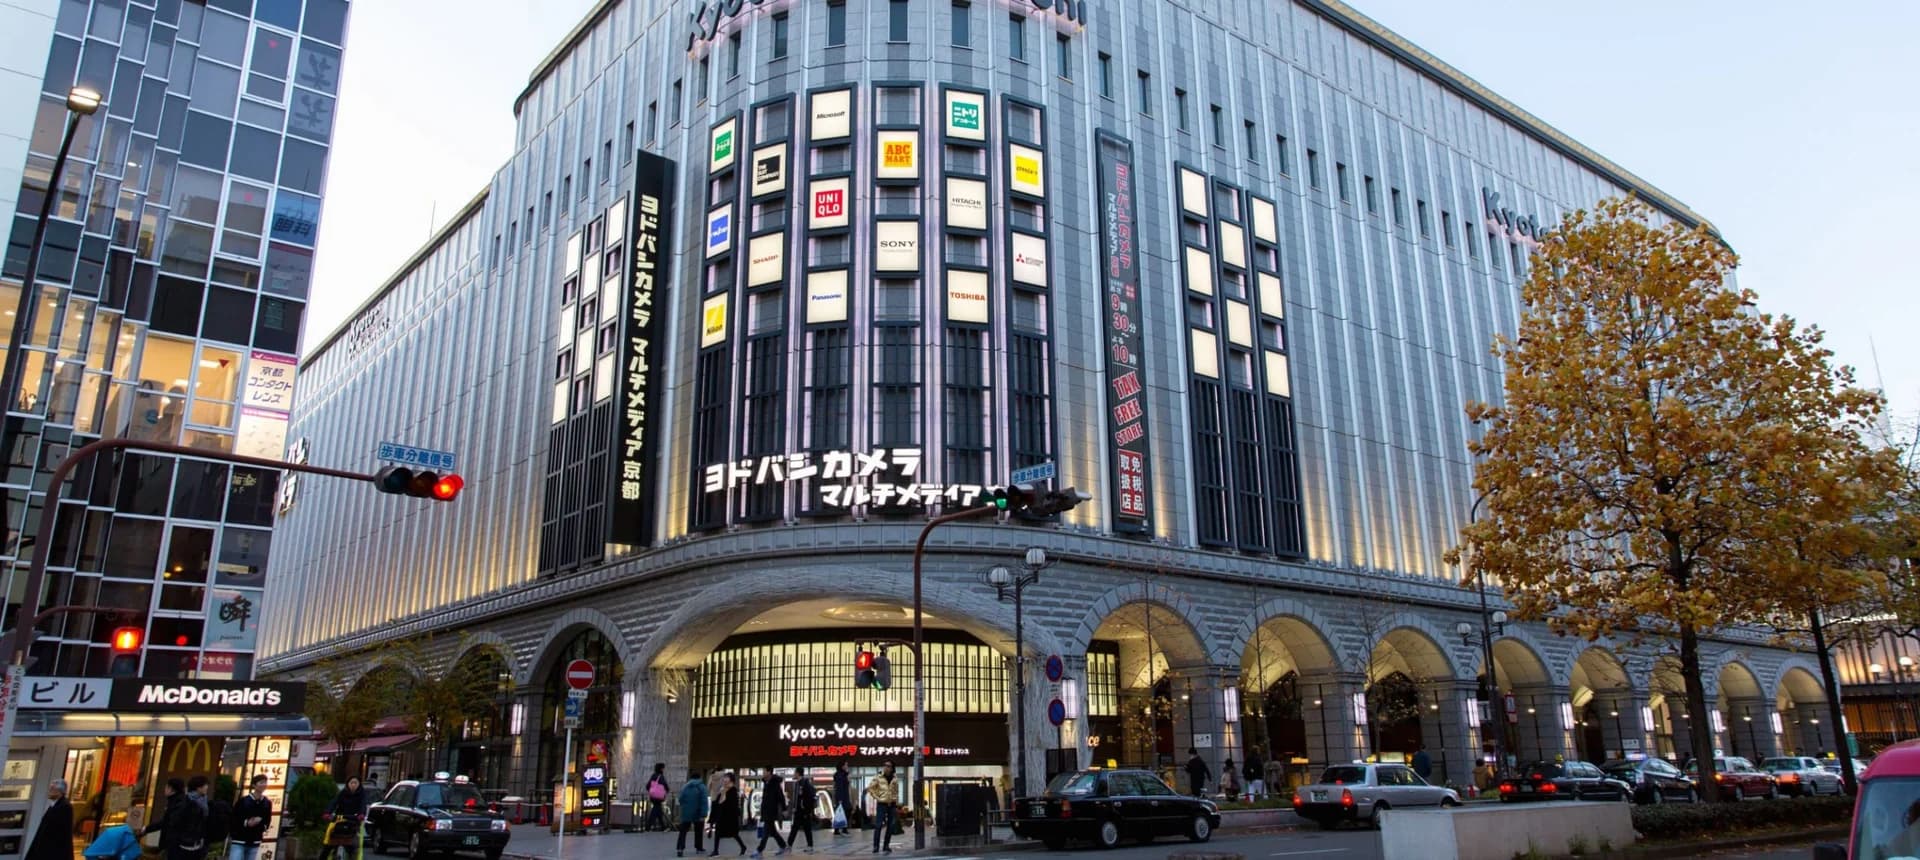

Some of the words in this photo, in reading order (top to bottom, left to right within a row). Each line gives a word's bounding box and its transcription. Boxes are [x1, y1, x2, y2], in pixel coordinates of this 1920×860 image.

[816, 111, 845, 119] Microsoft
[953, 105, 978, 118] ニトリ
[886, 144, 911, 155] ABC
[886, 155, 911, 163] MART
[817, 193, 840, 204] UNI
[952, 197, 981, 205] HITACHI
[817, 204, 841, 217] QLO
[880, 240, 915, 248] SONY
[633, 194, 659, 328] ヨドバシカメラ
[752, 254, 779, 265] SHARP
[949, 291, 986, 301] TOSHIBA
[260, 366, 284, 377] 京都
[248, 376, 292, 391] コンタクト
[1113, 371, 1141, 400] TAX
[252, 391, 284, 403] レンズ
[1114, 398, 1143, 426] FREE
[1115, 421, 1144, 447] STORE
[380, 445, 453, 468] 歩車分離信号
[705, 448, 922, 493] ヨドバシカメラ
[820, 483, 1008, 507] マルチメディア
[31, 682, 95, 704] ビル
[138, 685, 281, 706] McDonald's
[779, 723, 913, 742] Kyoto-Yodobash
[1086, 735, 1100, 748] ce
